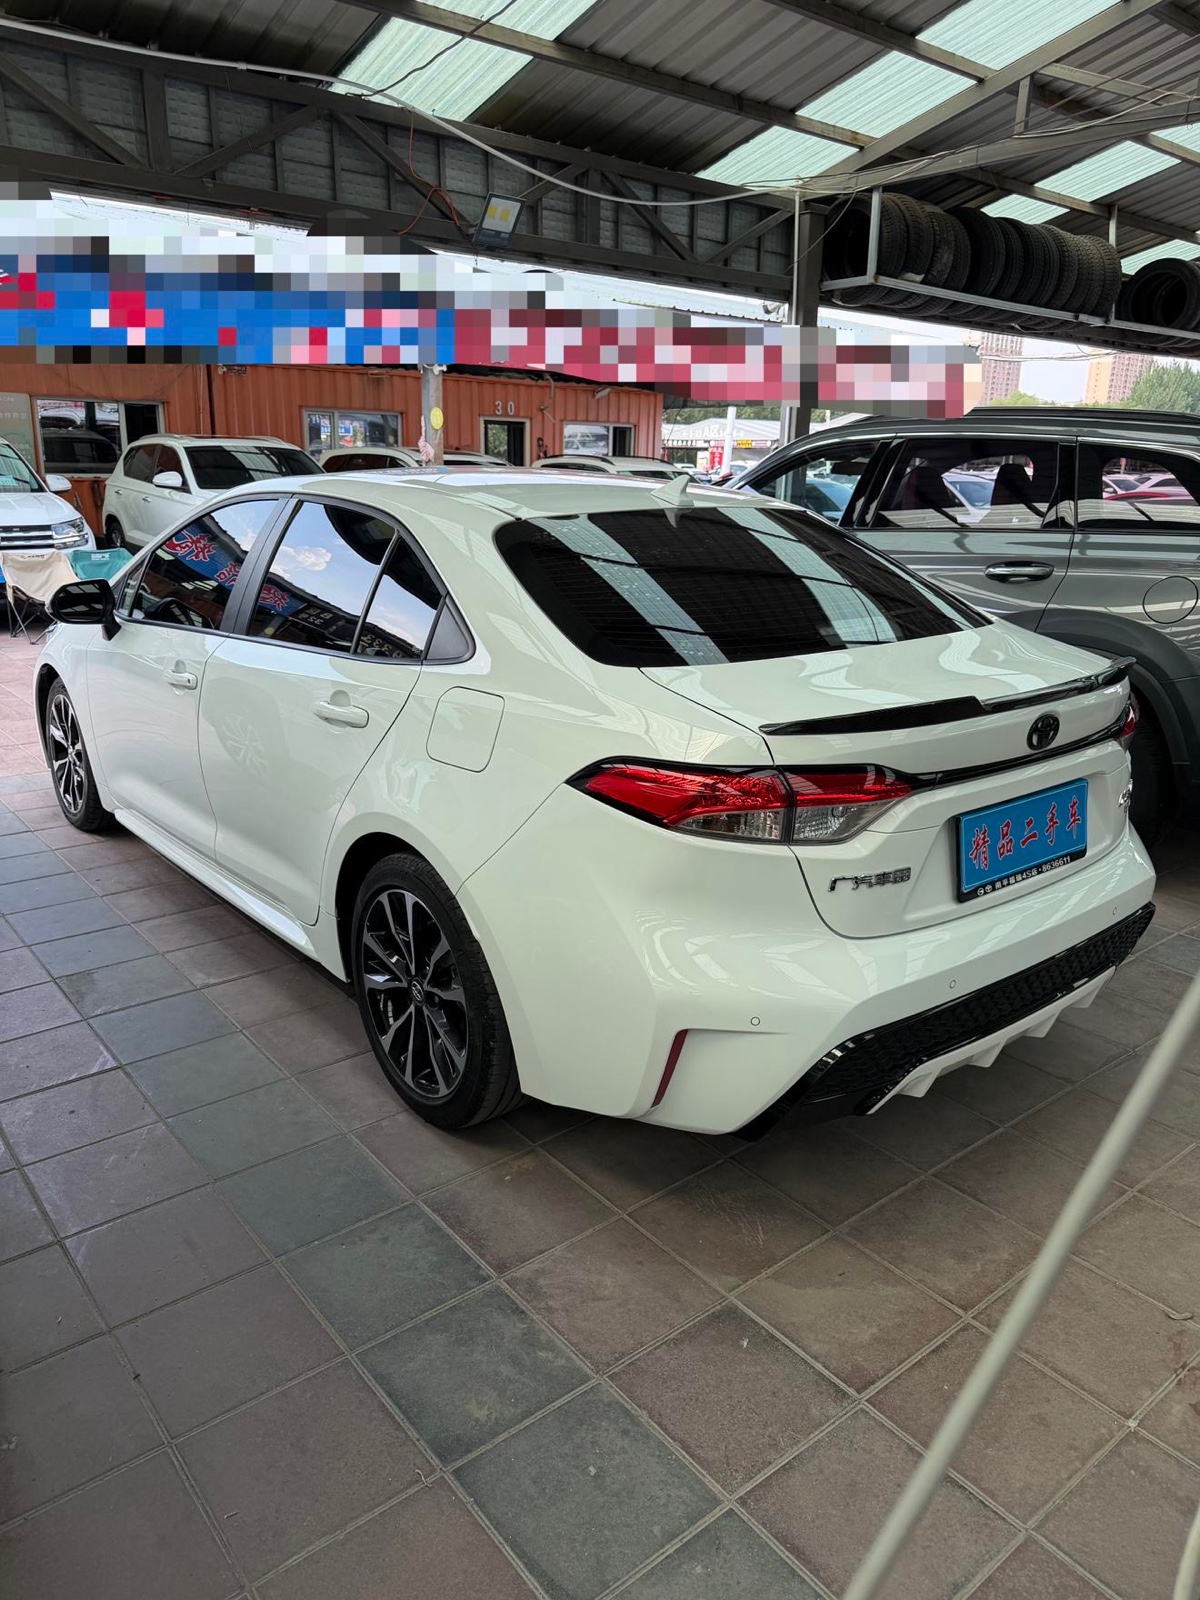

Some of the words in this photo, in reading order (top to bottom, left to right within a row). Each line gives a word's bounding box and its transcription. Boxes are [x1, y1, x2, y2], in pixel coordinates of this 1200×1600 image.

[495, 400, 515, 416] 30
[969, 795, 1082, 870] 精品二手车
